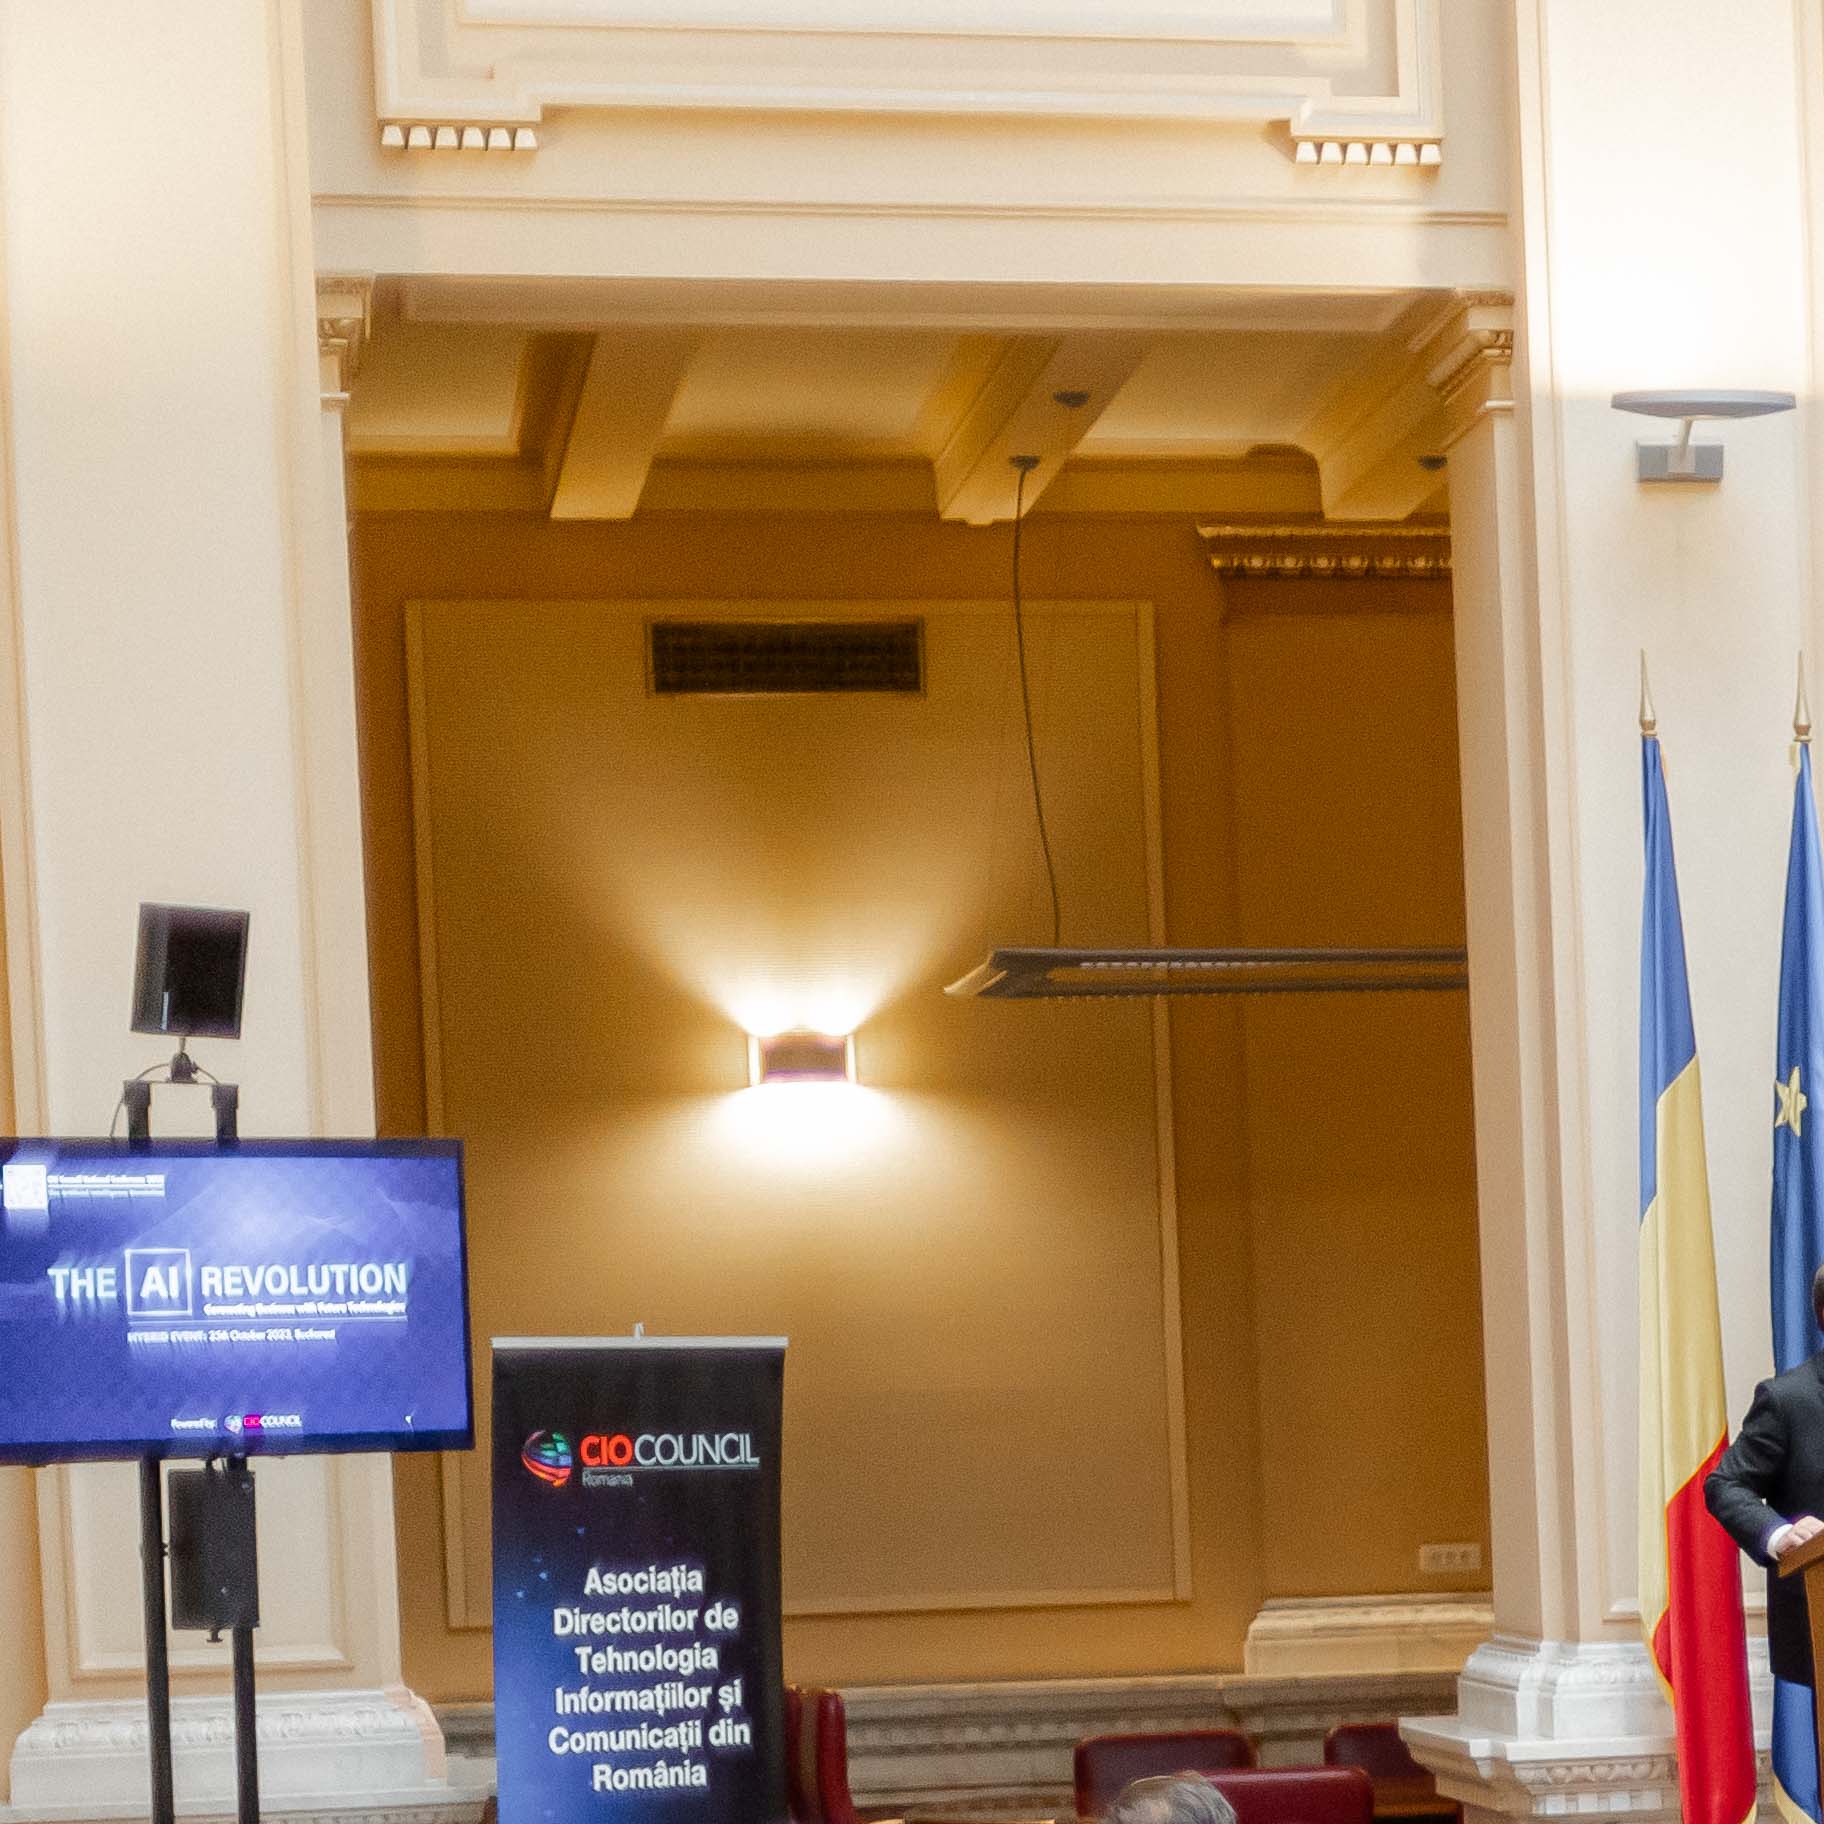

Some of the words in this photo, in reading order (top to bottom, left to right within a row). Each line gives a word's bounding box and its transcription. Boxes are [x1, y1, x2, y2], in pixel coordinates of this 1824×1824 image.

[46, 1267, 117, 1300] THE
[140, 1266, 178, 1299] AI
[200, 1263, 407, 1297] REVOLUTION
[553, 1604, 698, 1636] Directorilor
[704, 1602, 739, 1632] de
[574, 1642, 718, 1676] Tehnologia
[708, 1718, 750, 1746] din
[592, 1760, 707, 1792] România
